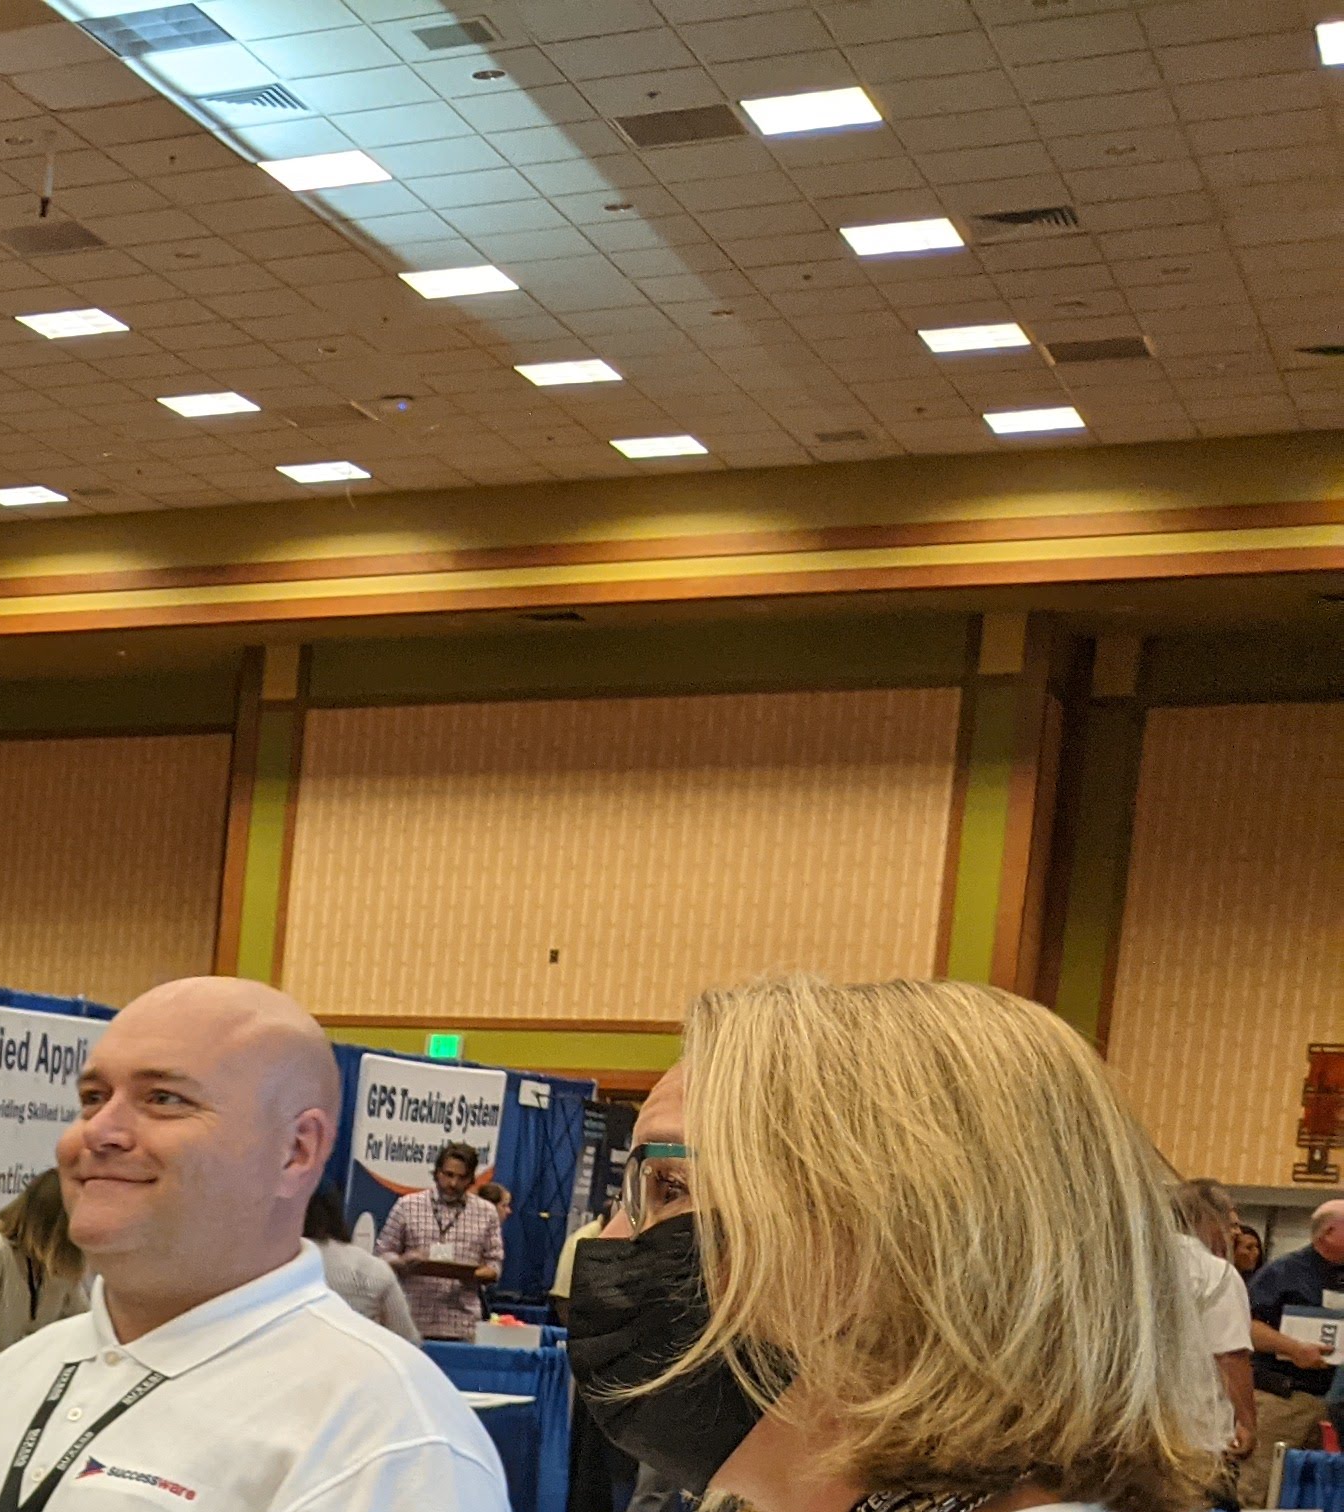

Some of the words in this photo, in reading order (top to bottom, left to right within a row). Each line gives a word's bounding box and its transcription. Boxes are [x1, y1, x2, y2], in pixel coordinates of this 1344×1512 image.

[27, 1103, 59, 1122] Skilled
[367, 1083, 397, 1120] GPS
[399, 1088, 455, 1133] Tracking
[455, 1094, 500, 1134] System
[366, 1133, 383, 1160] For
[384, 1133, 425, 1164] Vehicles
[106, 1466, 197, 1502] successware
